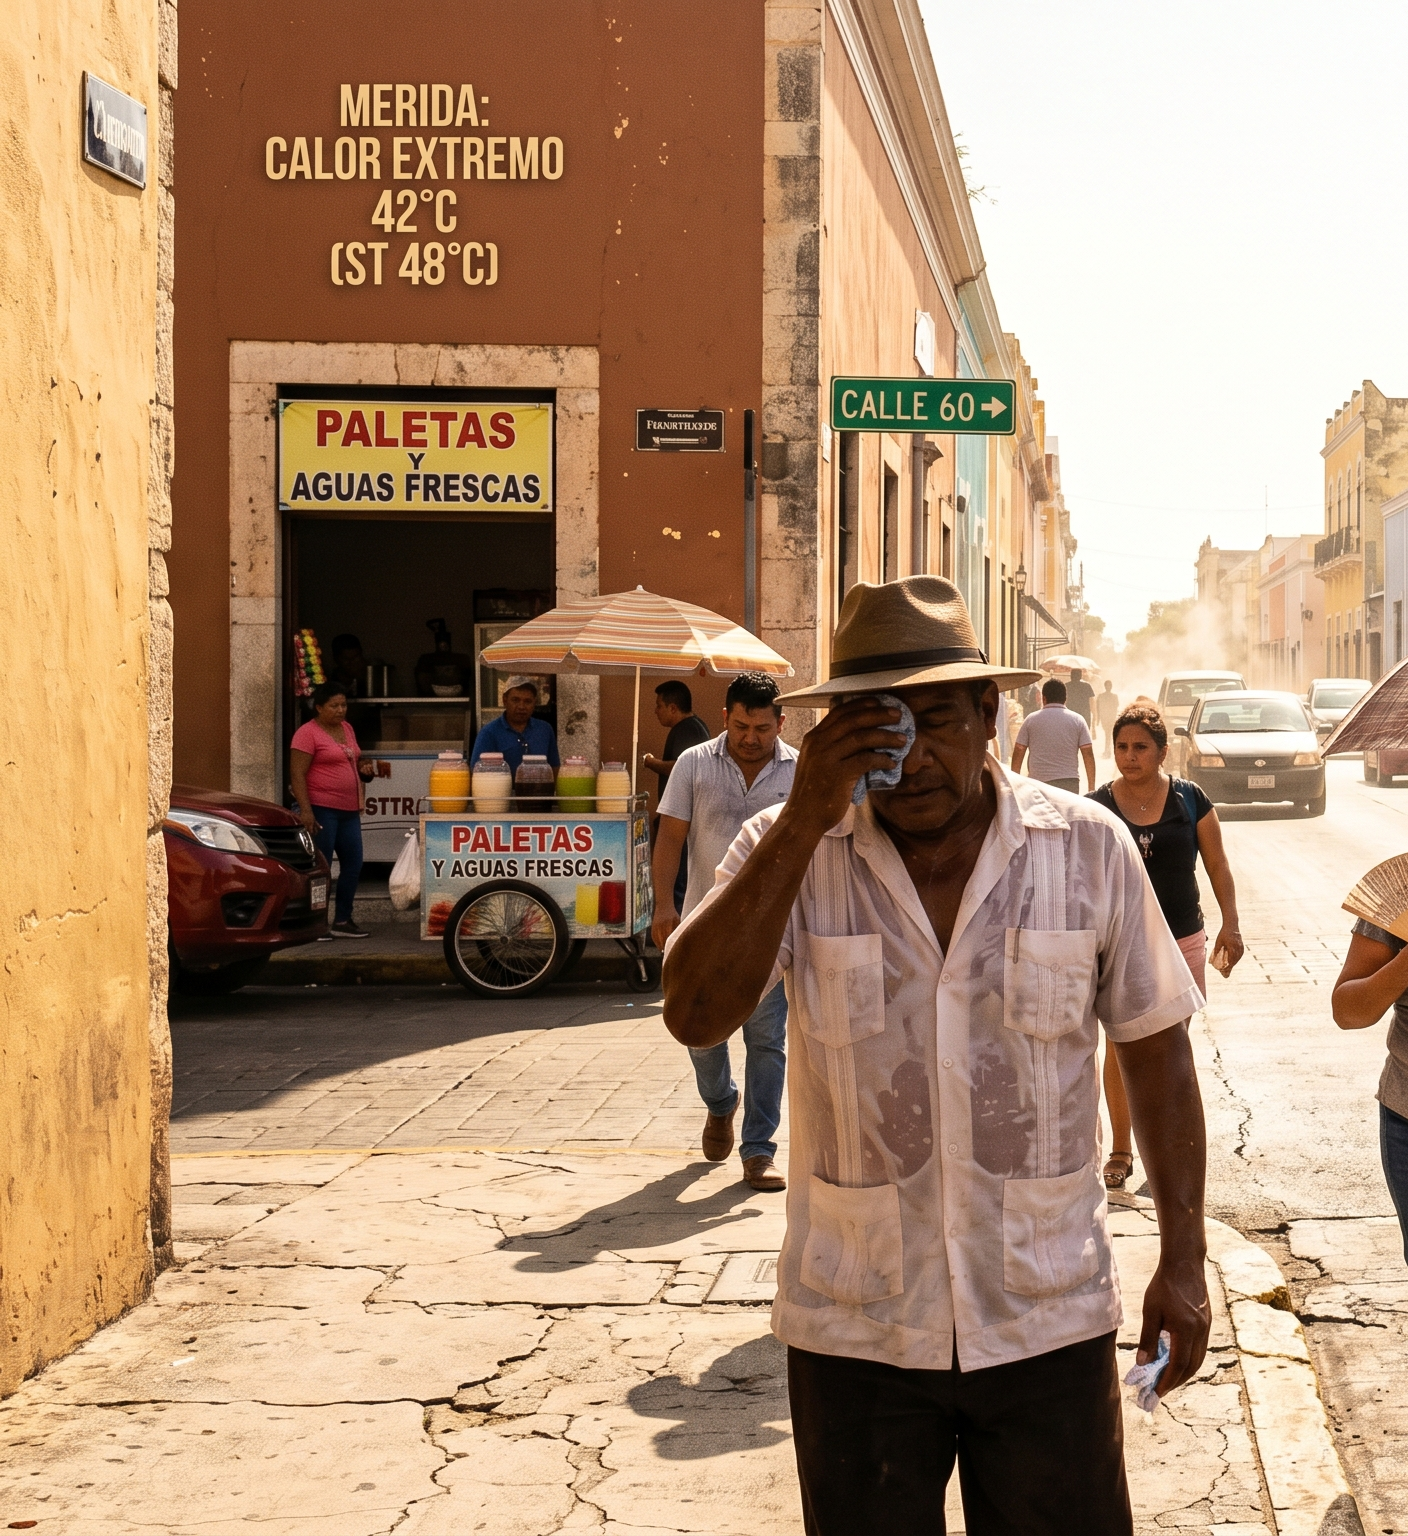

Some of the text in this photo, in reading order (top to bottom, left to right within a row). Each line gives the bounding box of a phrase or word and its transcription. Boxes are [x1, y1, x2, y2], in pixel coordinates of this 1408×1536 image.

[841, 389, 975, 422] CALLE 60
[316, 409, 517, 450] PALETAS
[407, 452, 426, 471] Y
[290, 471, 541, 504] AGUAS FRESCAS
[451, 825, 594, 853] PALETAS
[431, 858, 615, 878] Y AGUAS FRESCAS
